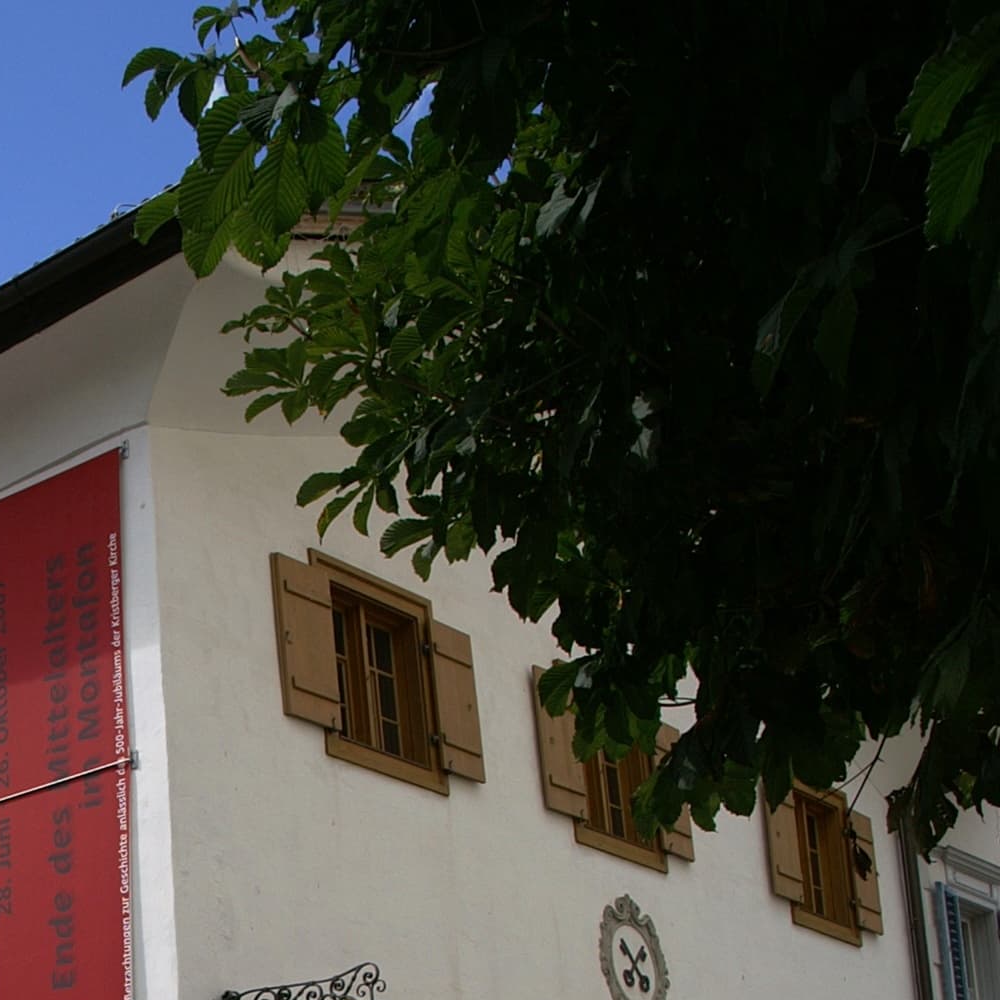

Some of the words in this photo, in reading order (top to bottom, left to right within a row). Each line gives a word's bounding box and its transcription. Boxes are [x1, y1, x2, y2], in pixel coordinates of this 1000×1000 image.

[107, 533, 118, 567] Kirche
[109, 569, 121, 628] Kristberger
[71, 541, 102, 741] Montafon
[111, 631, 121, 648] der
[116, 778, 128, 831] anlässlich
[47, 807, 73, 875] des
[118, 834, 129, 894] Geschichte
[47, 891, 75, 992] Ende
